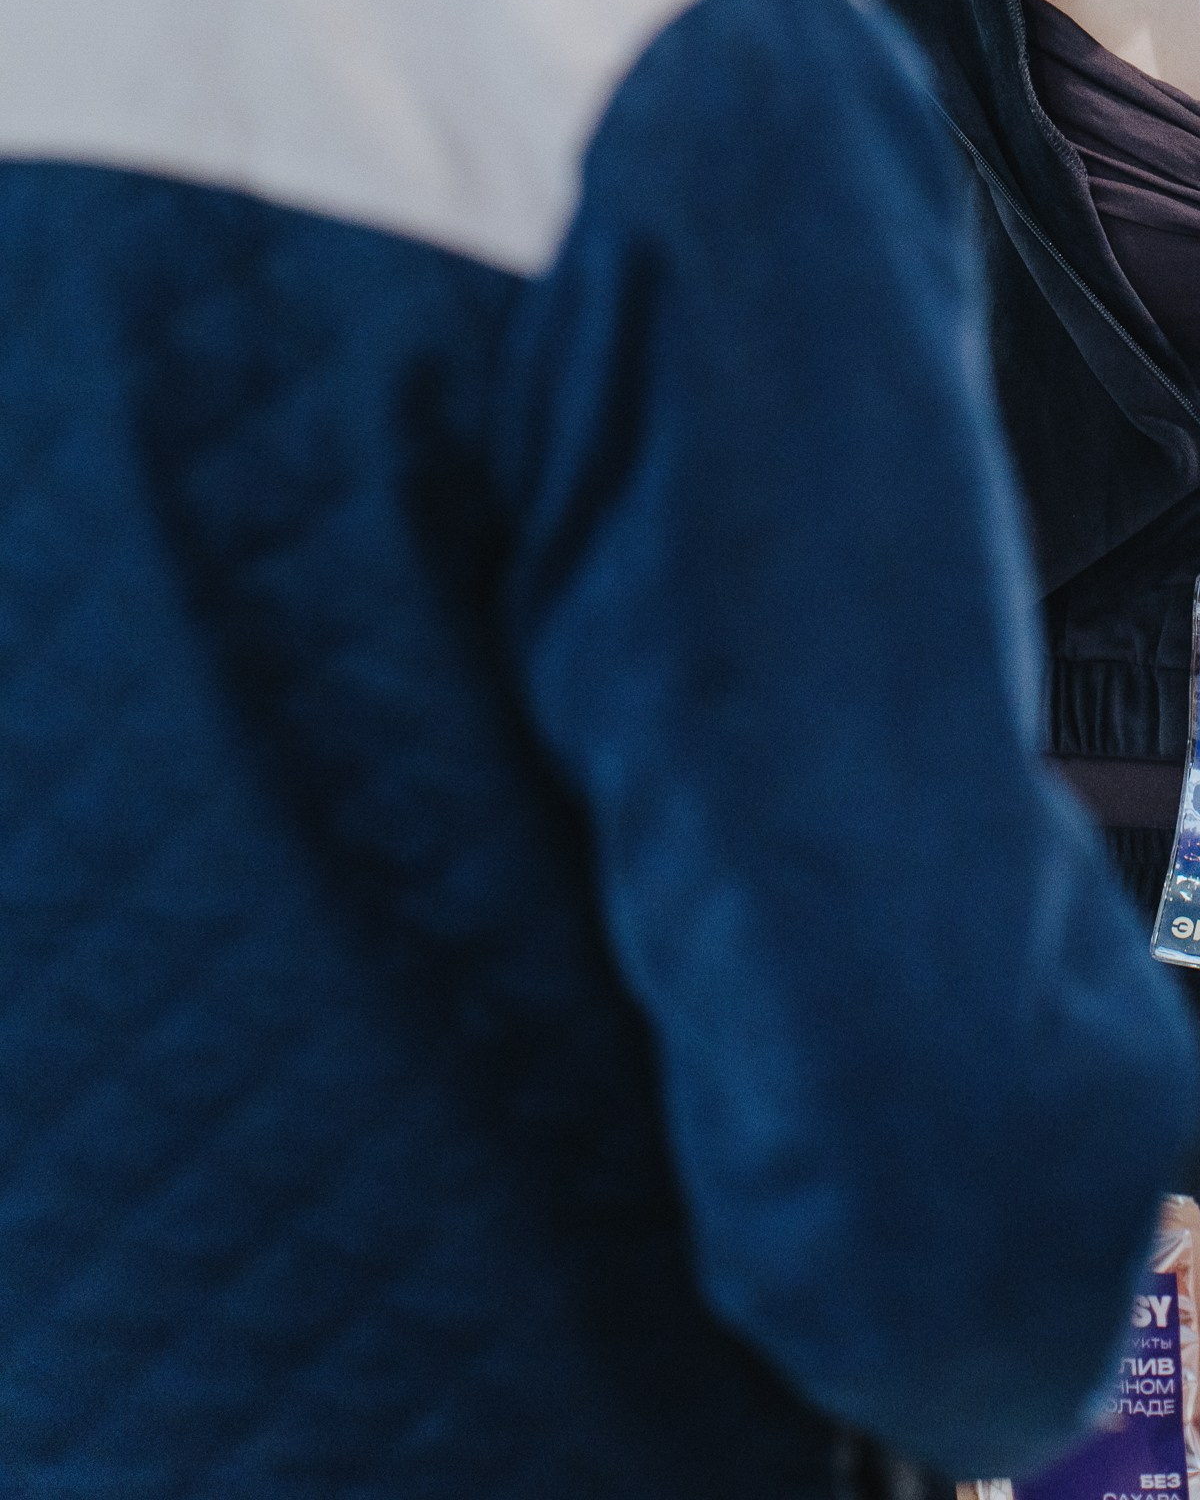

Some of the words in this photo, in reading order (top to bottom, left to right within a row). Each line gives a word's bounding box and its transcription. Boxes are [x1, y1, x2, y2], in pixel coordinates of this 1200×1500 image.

[1119, 1357, 1176, 1376] ЛИВ
[1120, 1378, 1175, 1395] НОМ
[1140, 1472, 1181, 1489] БЕЗ
